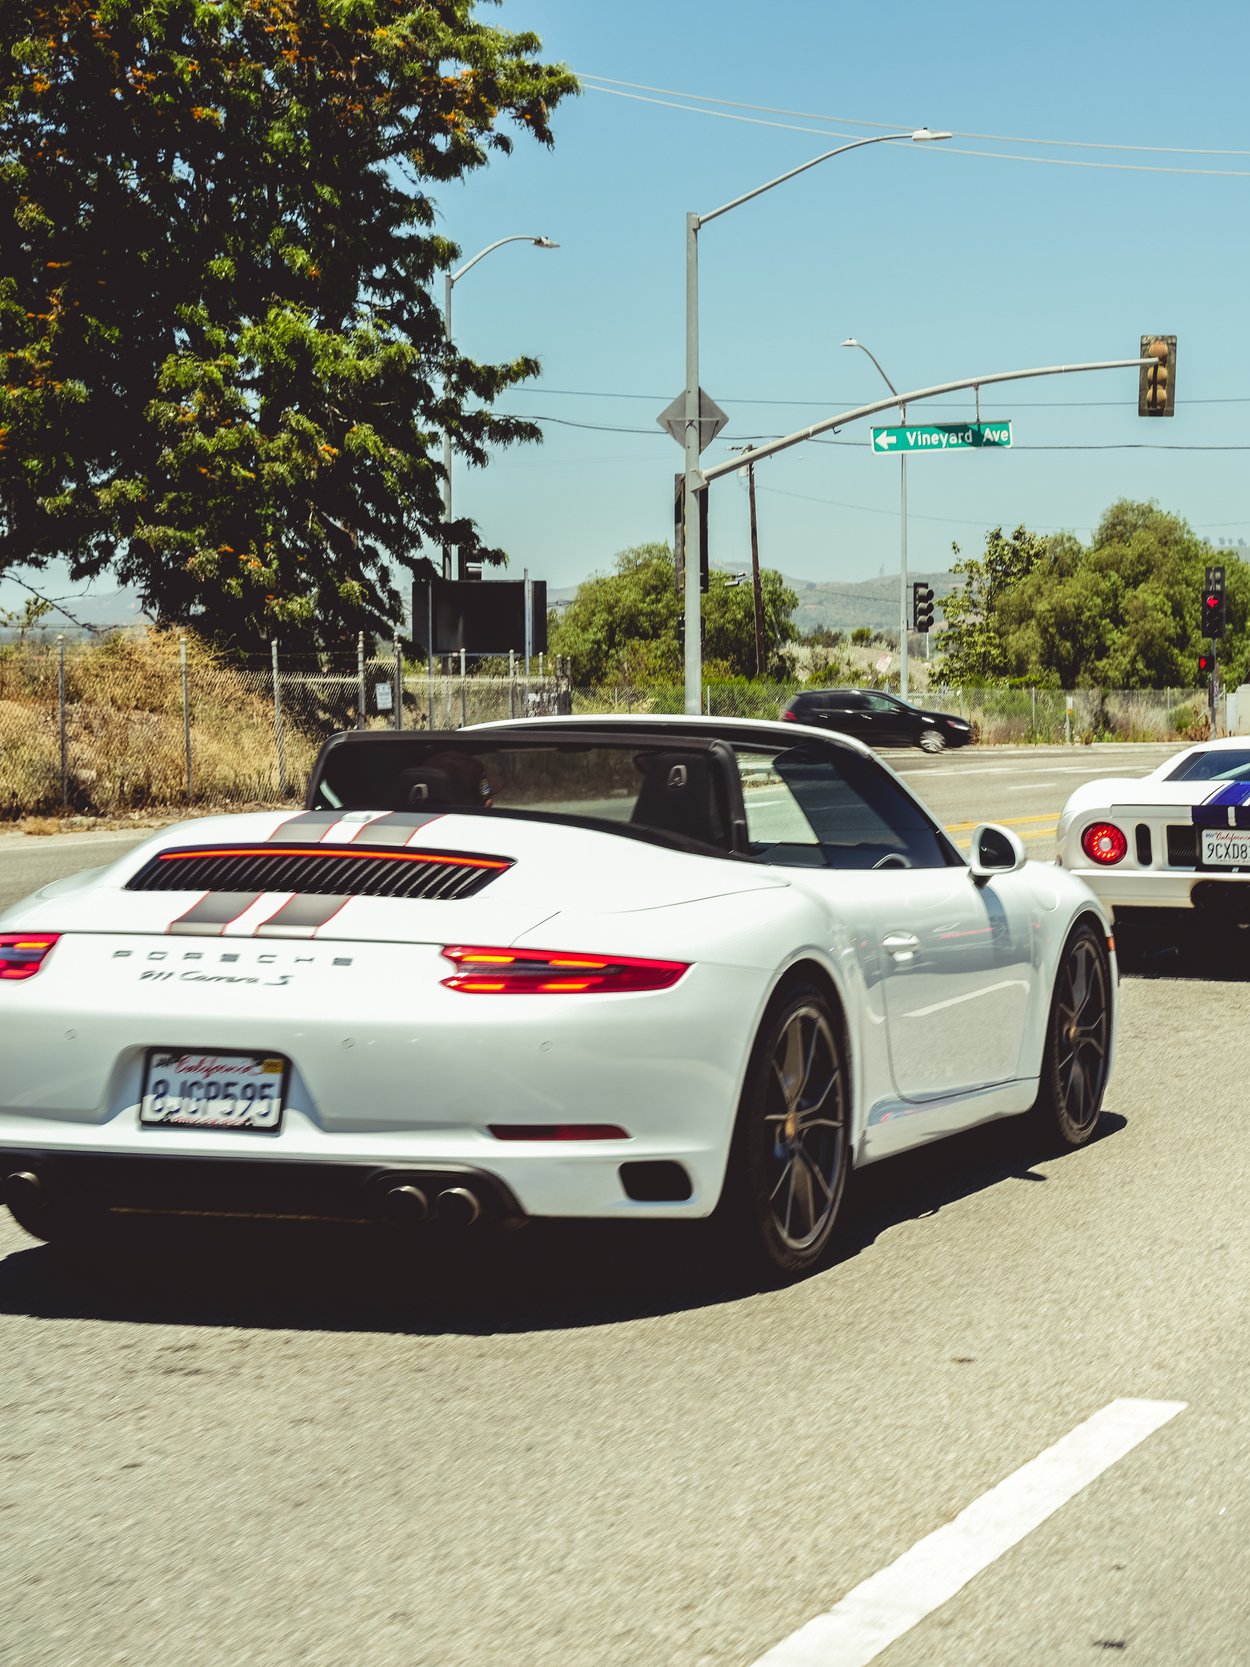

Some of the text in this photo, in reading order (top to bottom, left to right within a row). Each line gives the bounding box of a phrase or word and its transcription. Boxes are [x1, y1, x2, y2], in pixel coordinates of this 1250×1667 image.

[906, 428, 1009, 448] Vineyard Ave
[112, 950, 353, 966] PORSCHE
[179, 971, 260, 984] Carrera
[263, 975, 296, 986] S
[152, 1078, 276, 1118] 8JGP595
